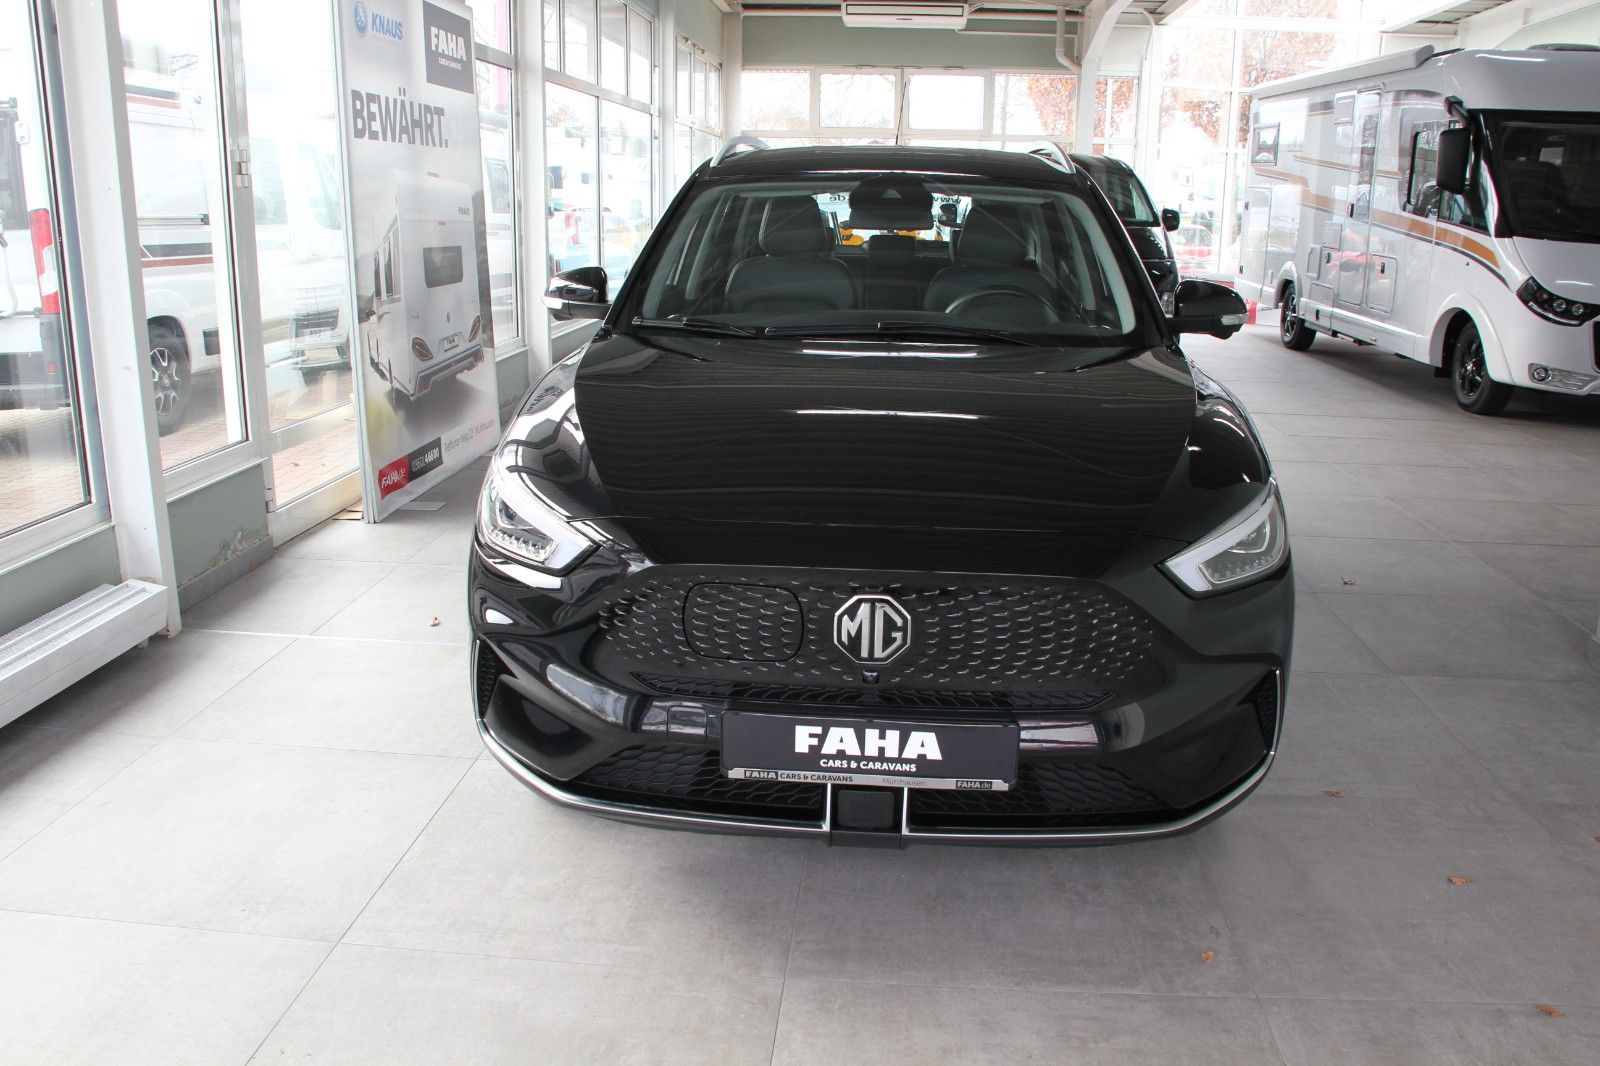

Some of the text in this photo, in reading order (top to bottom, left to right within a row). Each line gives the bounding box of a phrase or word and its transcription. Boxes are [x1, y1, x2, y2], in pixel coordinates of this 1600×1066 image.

[371, 12, 403, 40] KNAUS
[430, 25, 467, 61] FAHA
[350, 87, 448, 148] BEWÄHRT.
[841, 602, 903, 659] MG
[794, 724, 943, 761] FAHA
[745, 770, 777, 780] FAHA
[779, 773, 802, 781] CARS
[810, 774, 853, 783] CARAVANS
[956, 781, 992, 789] FAHA.de
[819, 758, 917, 772] CARS & CARAVANS
